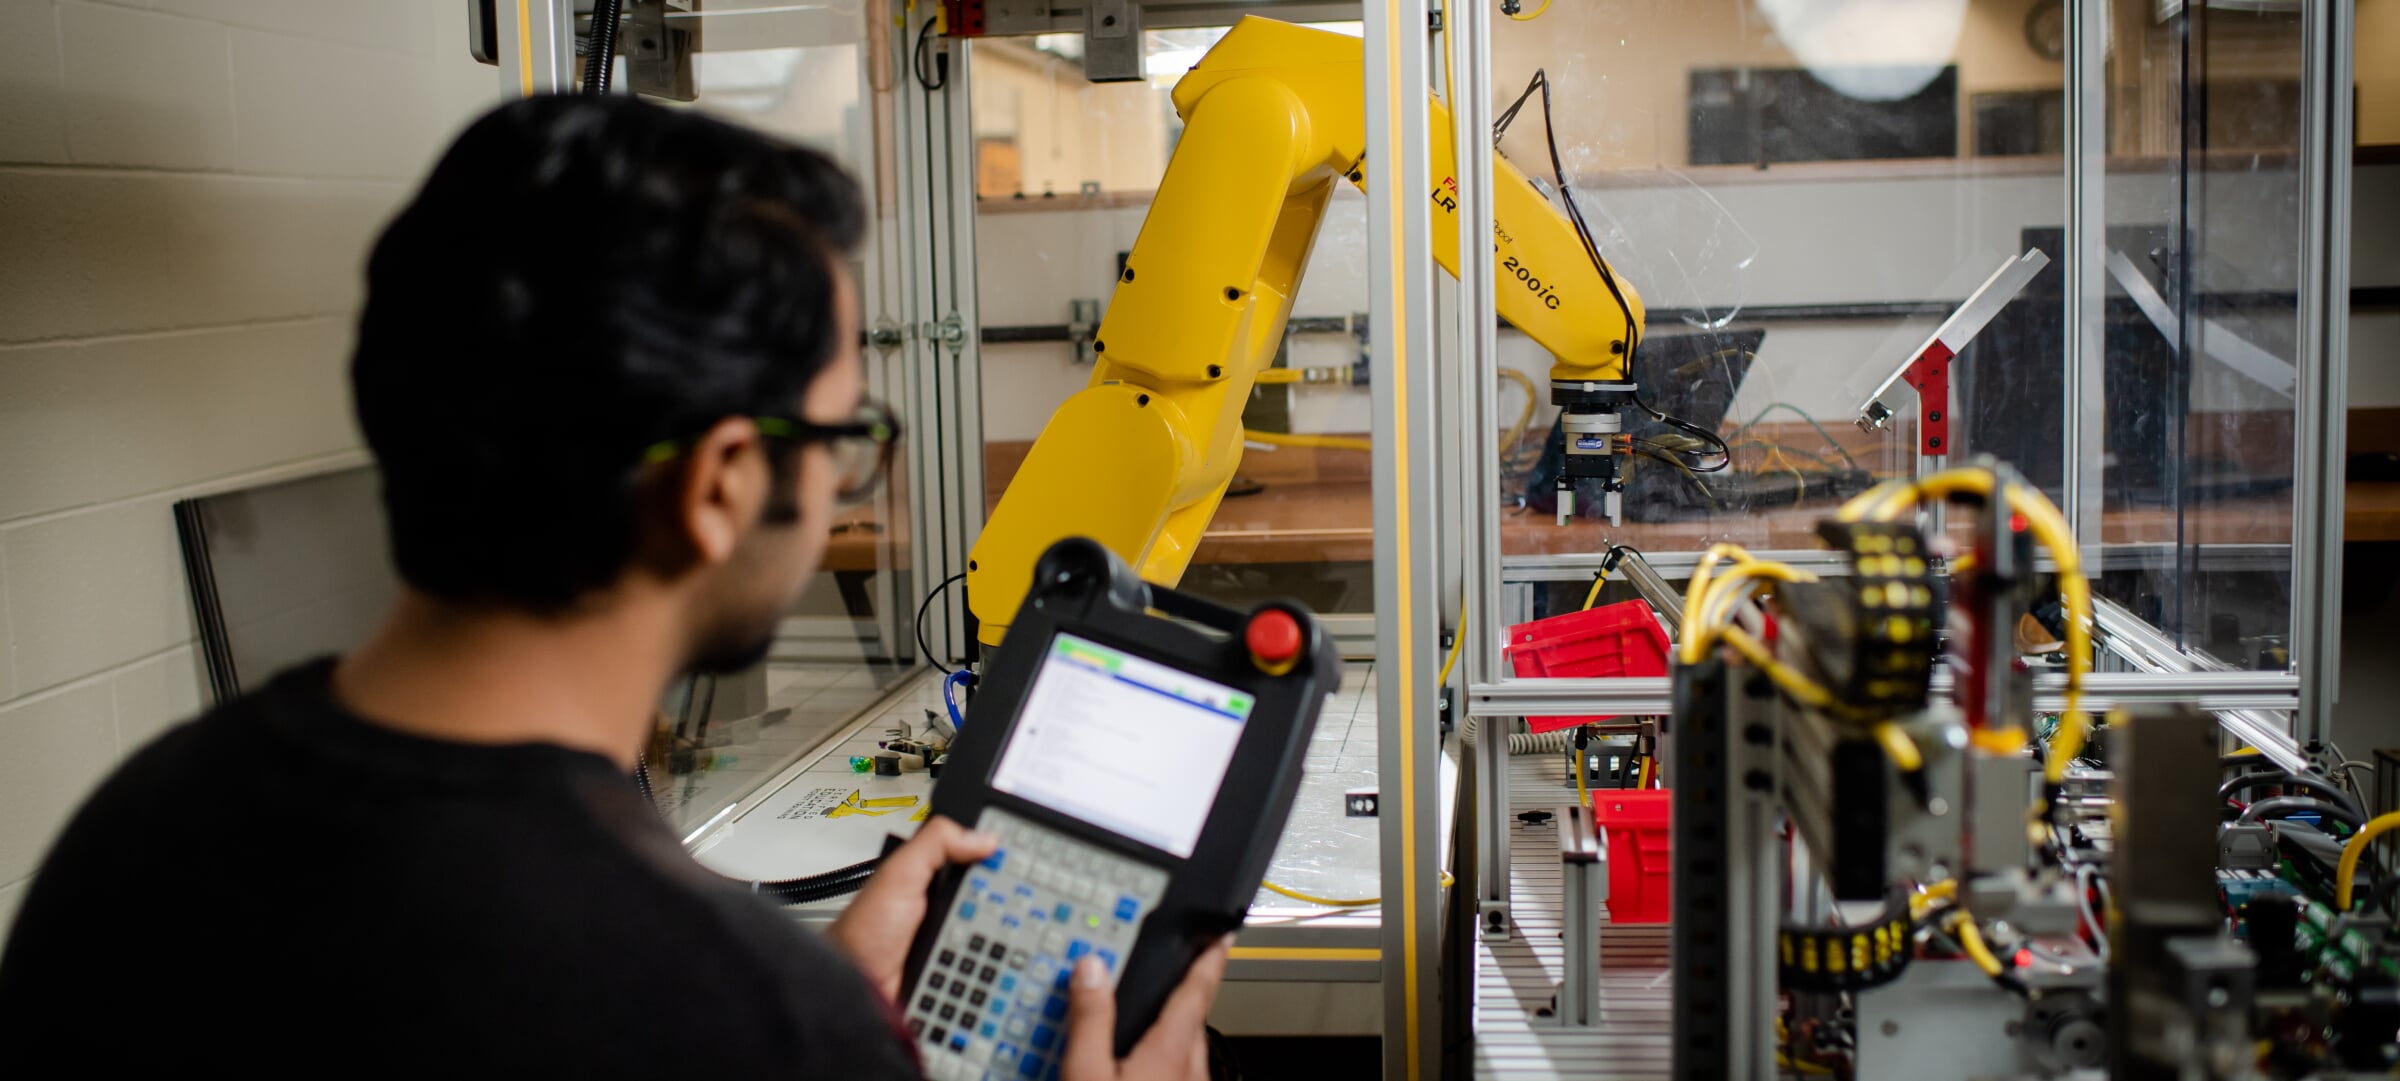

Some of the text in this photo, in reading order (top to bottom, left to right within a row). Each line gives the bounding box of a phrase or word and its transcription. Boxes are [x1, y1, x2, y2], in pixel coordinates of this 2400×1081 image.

[1442, 176, 1457, 196] FA
[1431, 187, 1560, 310] LR 200iC
[788, 788, 836, 820] EDUCATION
